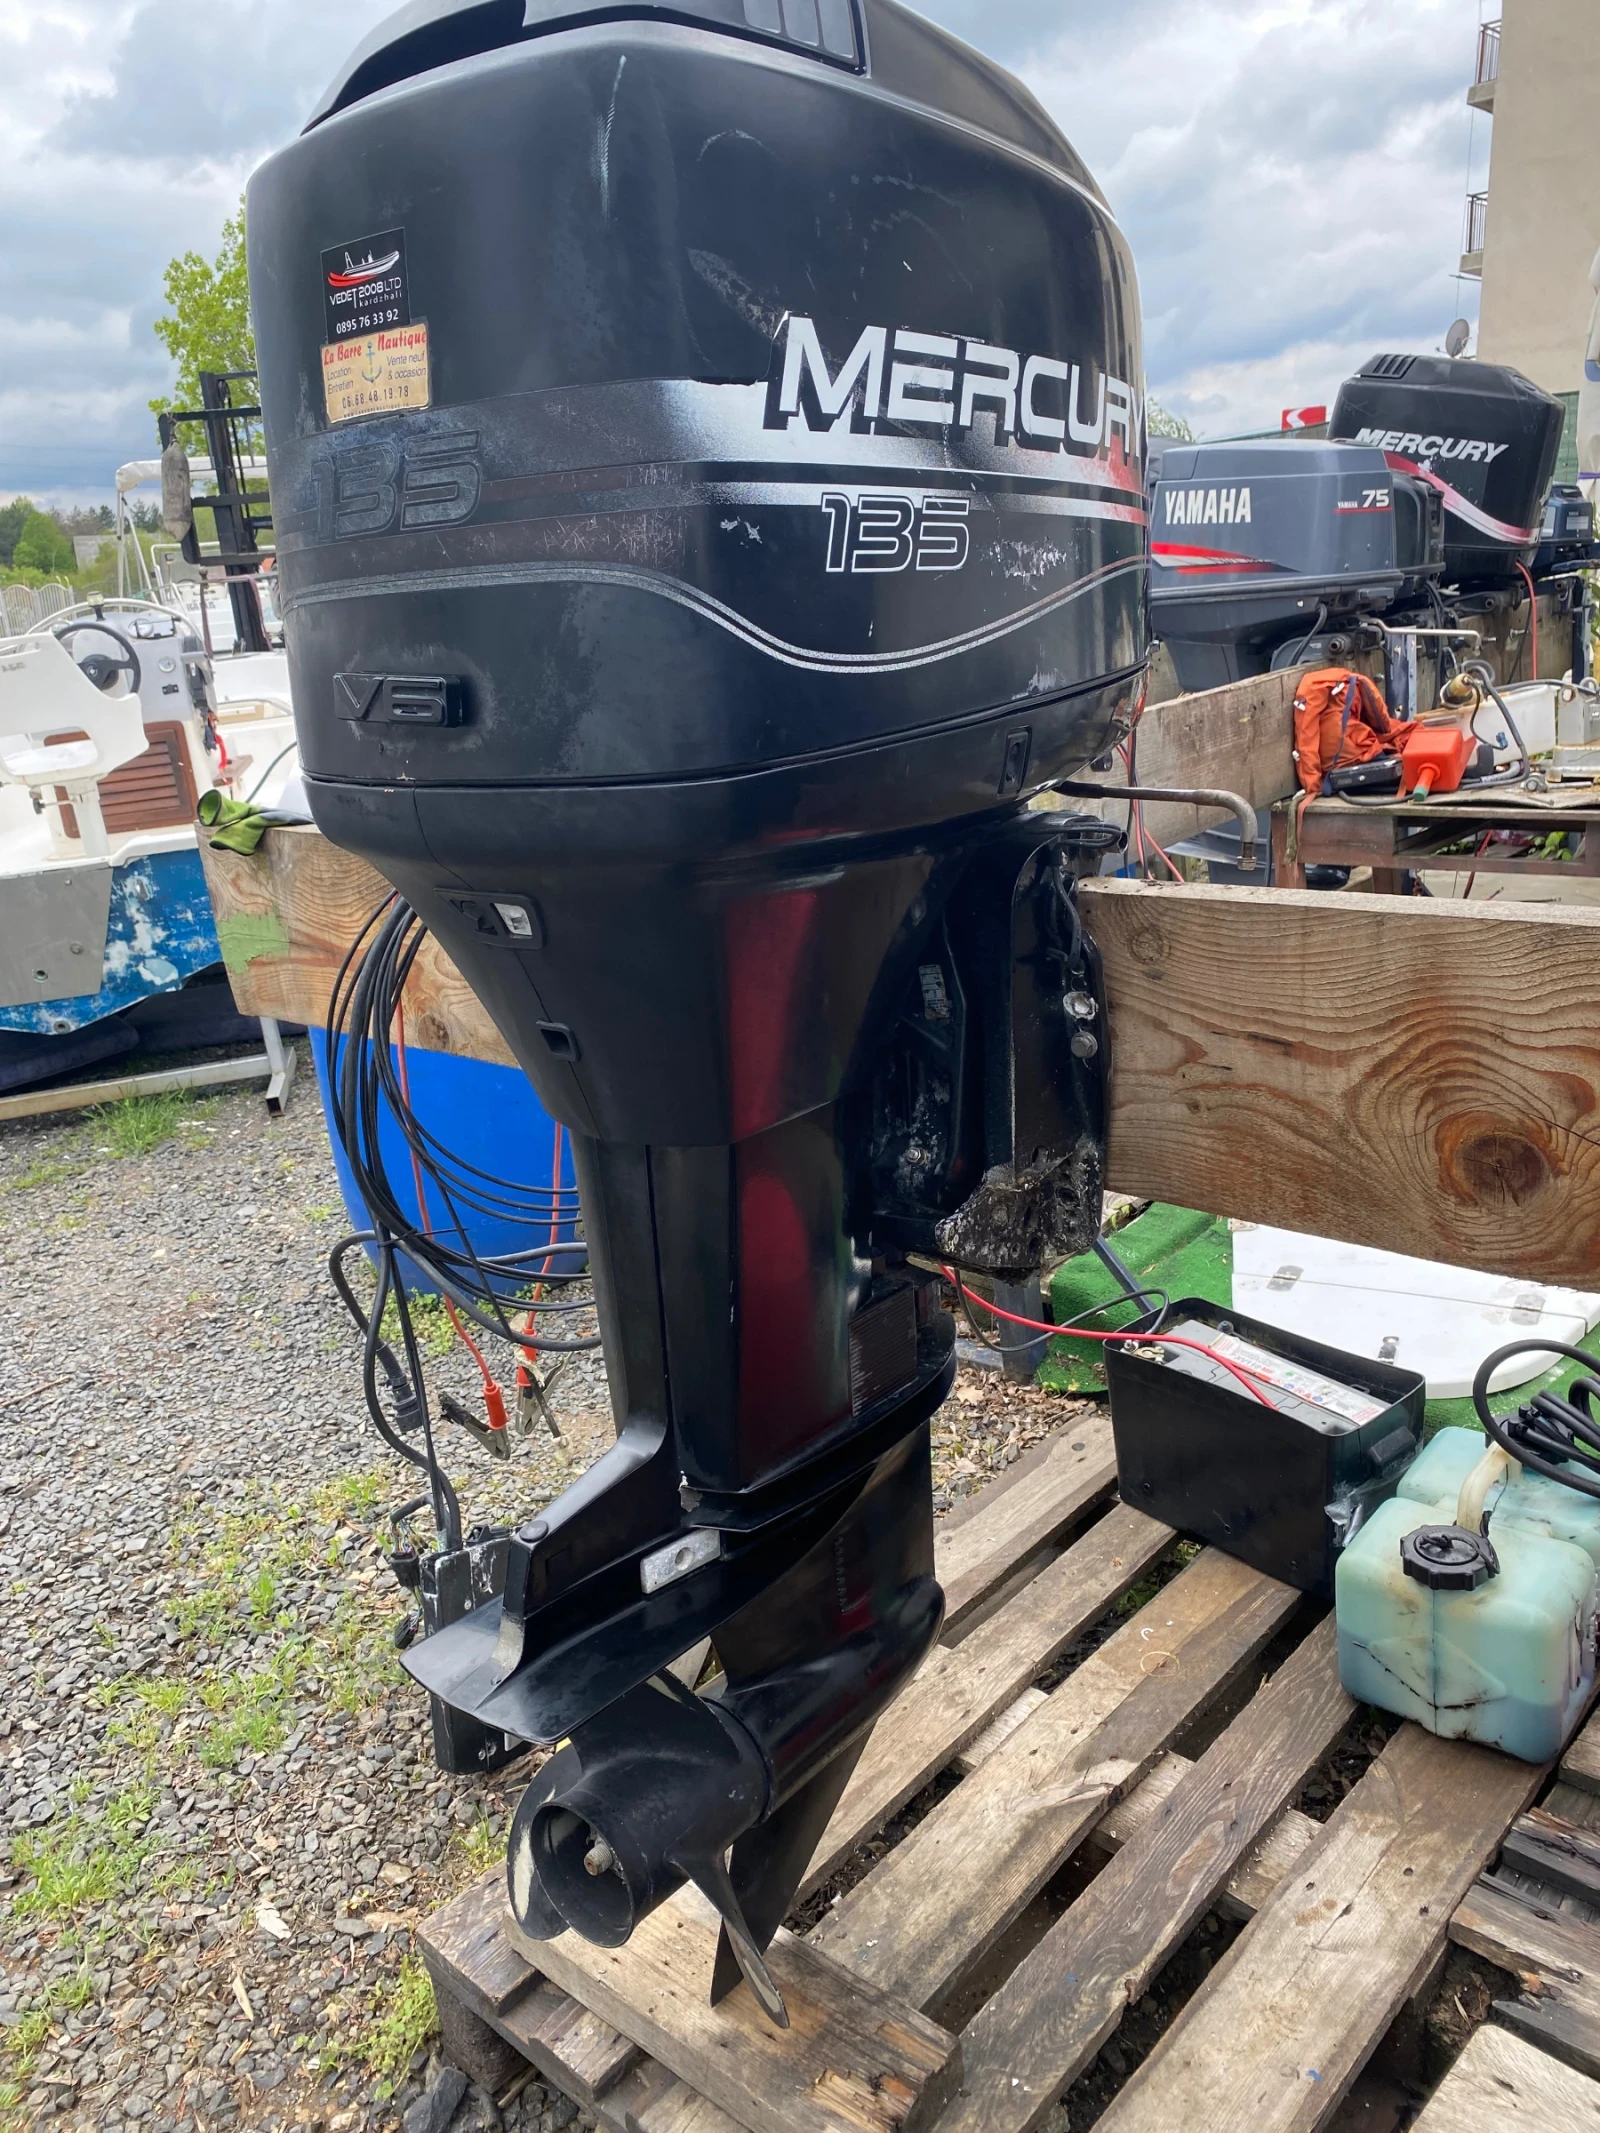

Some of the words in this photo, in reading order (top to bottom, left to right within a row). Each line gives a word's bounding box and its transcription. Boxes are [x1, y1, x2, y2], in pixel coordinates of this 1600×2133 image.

[330, 288, 358, 308] VEDET
[359, 290, 402, 307] kardzhali
[336, 319, 357, 334] 0895
[359, 316, 370, 328] 76
[373, 312, 384, 325] 33
[386, 308, 399, 321] 92
[324, 348, 335, 366] La
[337, 344, 362, 361] Barre
[377, 330, 427, 351] Nautique
[386, 355, 407, 366] Vente
[408, 350, 425, 363] neuf
[327, 366, 352, 381] Location
[387, 371, 393, 380] &
[394, 367, 427, 379] occasion
[327, 380, 354, 395] Entretien
[779, 317, 1144, 457] MERCURY
[1355, 427, 1510, 463] MERCURY
[311, 428, 483, 542] 135
[1165, 487, 1252, 525] YAMAHA
[1362, 489, 1390, 508] 75
[821, 492, 970, 573] 135
[333, 674, 448, 726] V6
